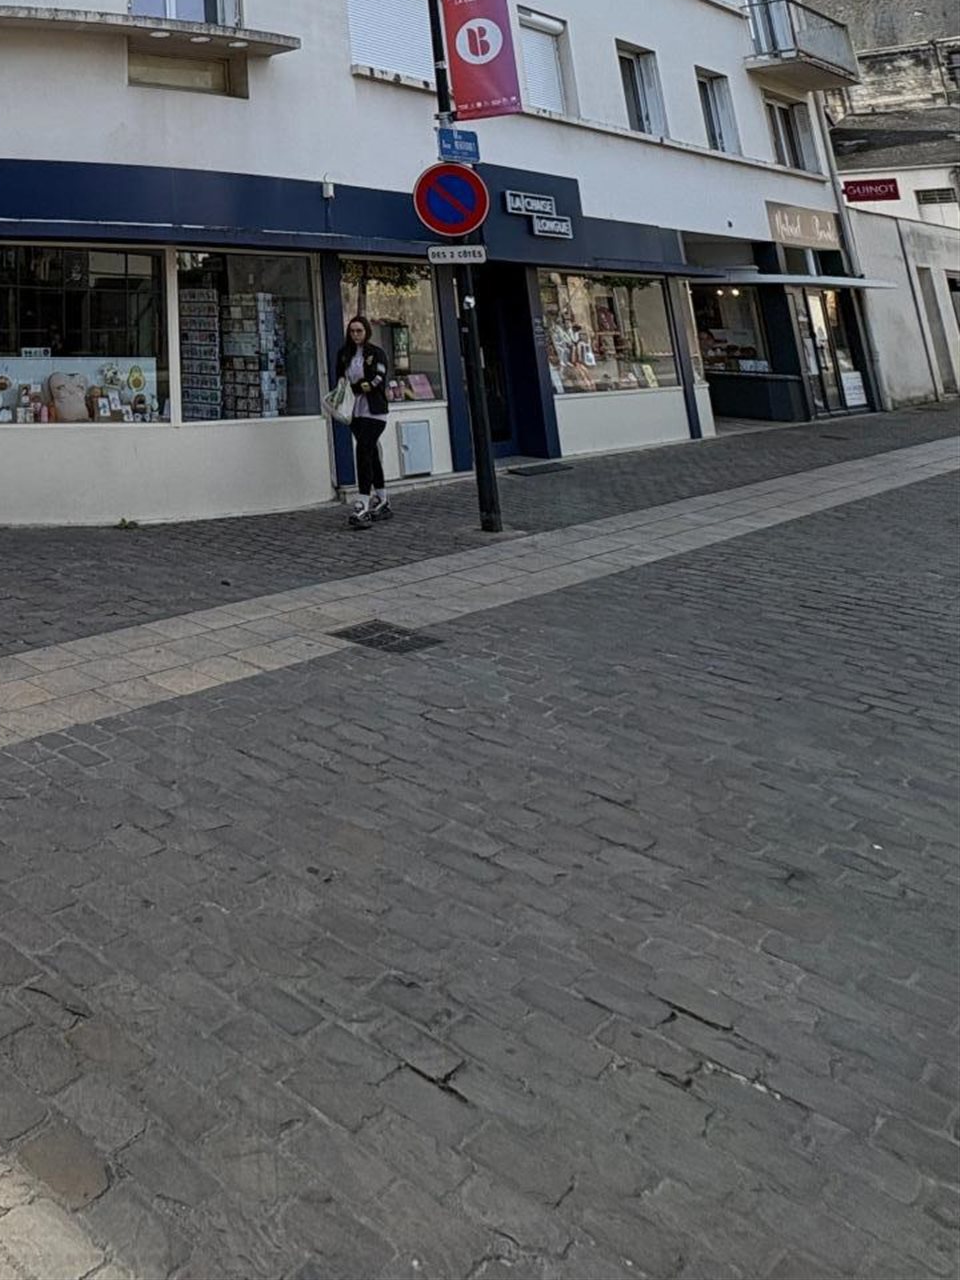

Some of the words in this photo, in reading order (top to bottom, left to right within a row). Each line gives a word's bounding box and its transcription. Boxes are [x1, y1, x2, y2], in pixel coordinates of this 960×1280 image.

[846, 184, 895, 195] GUINOT
[511, 196, 522, 209] LA
[525, 198, 553, 213] CHAISE
[536, 218, 570, 233] LONGUE
[431, 251, 447, 259] DES
